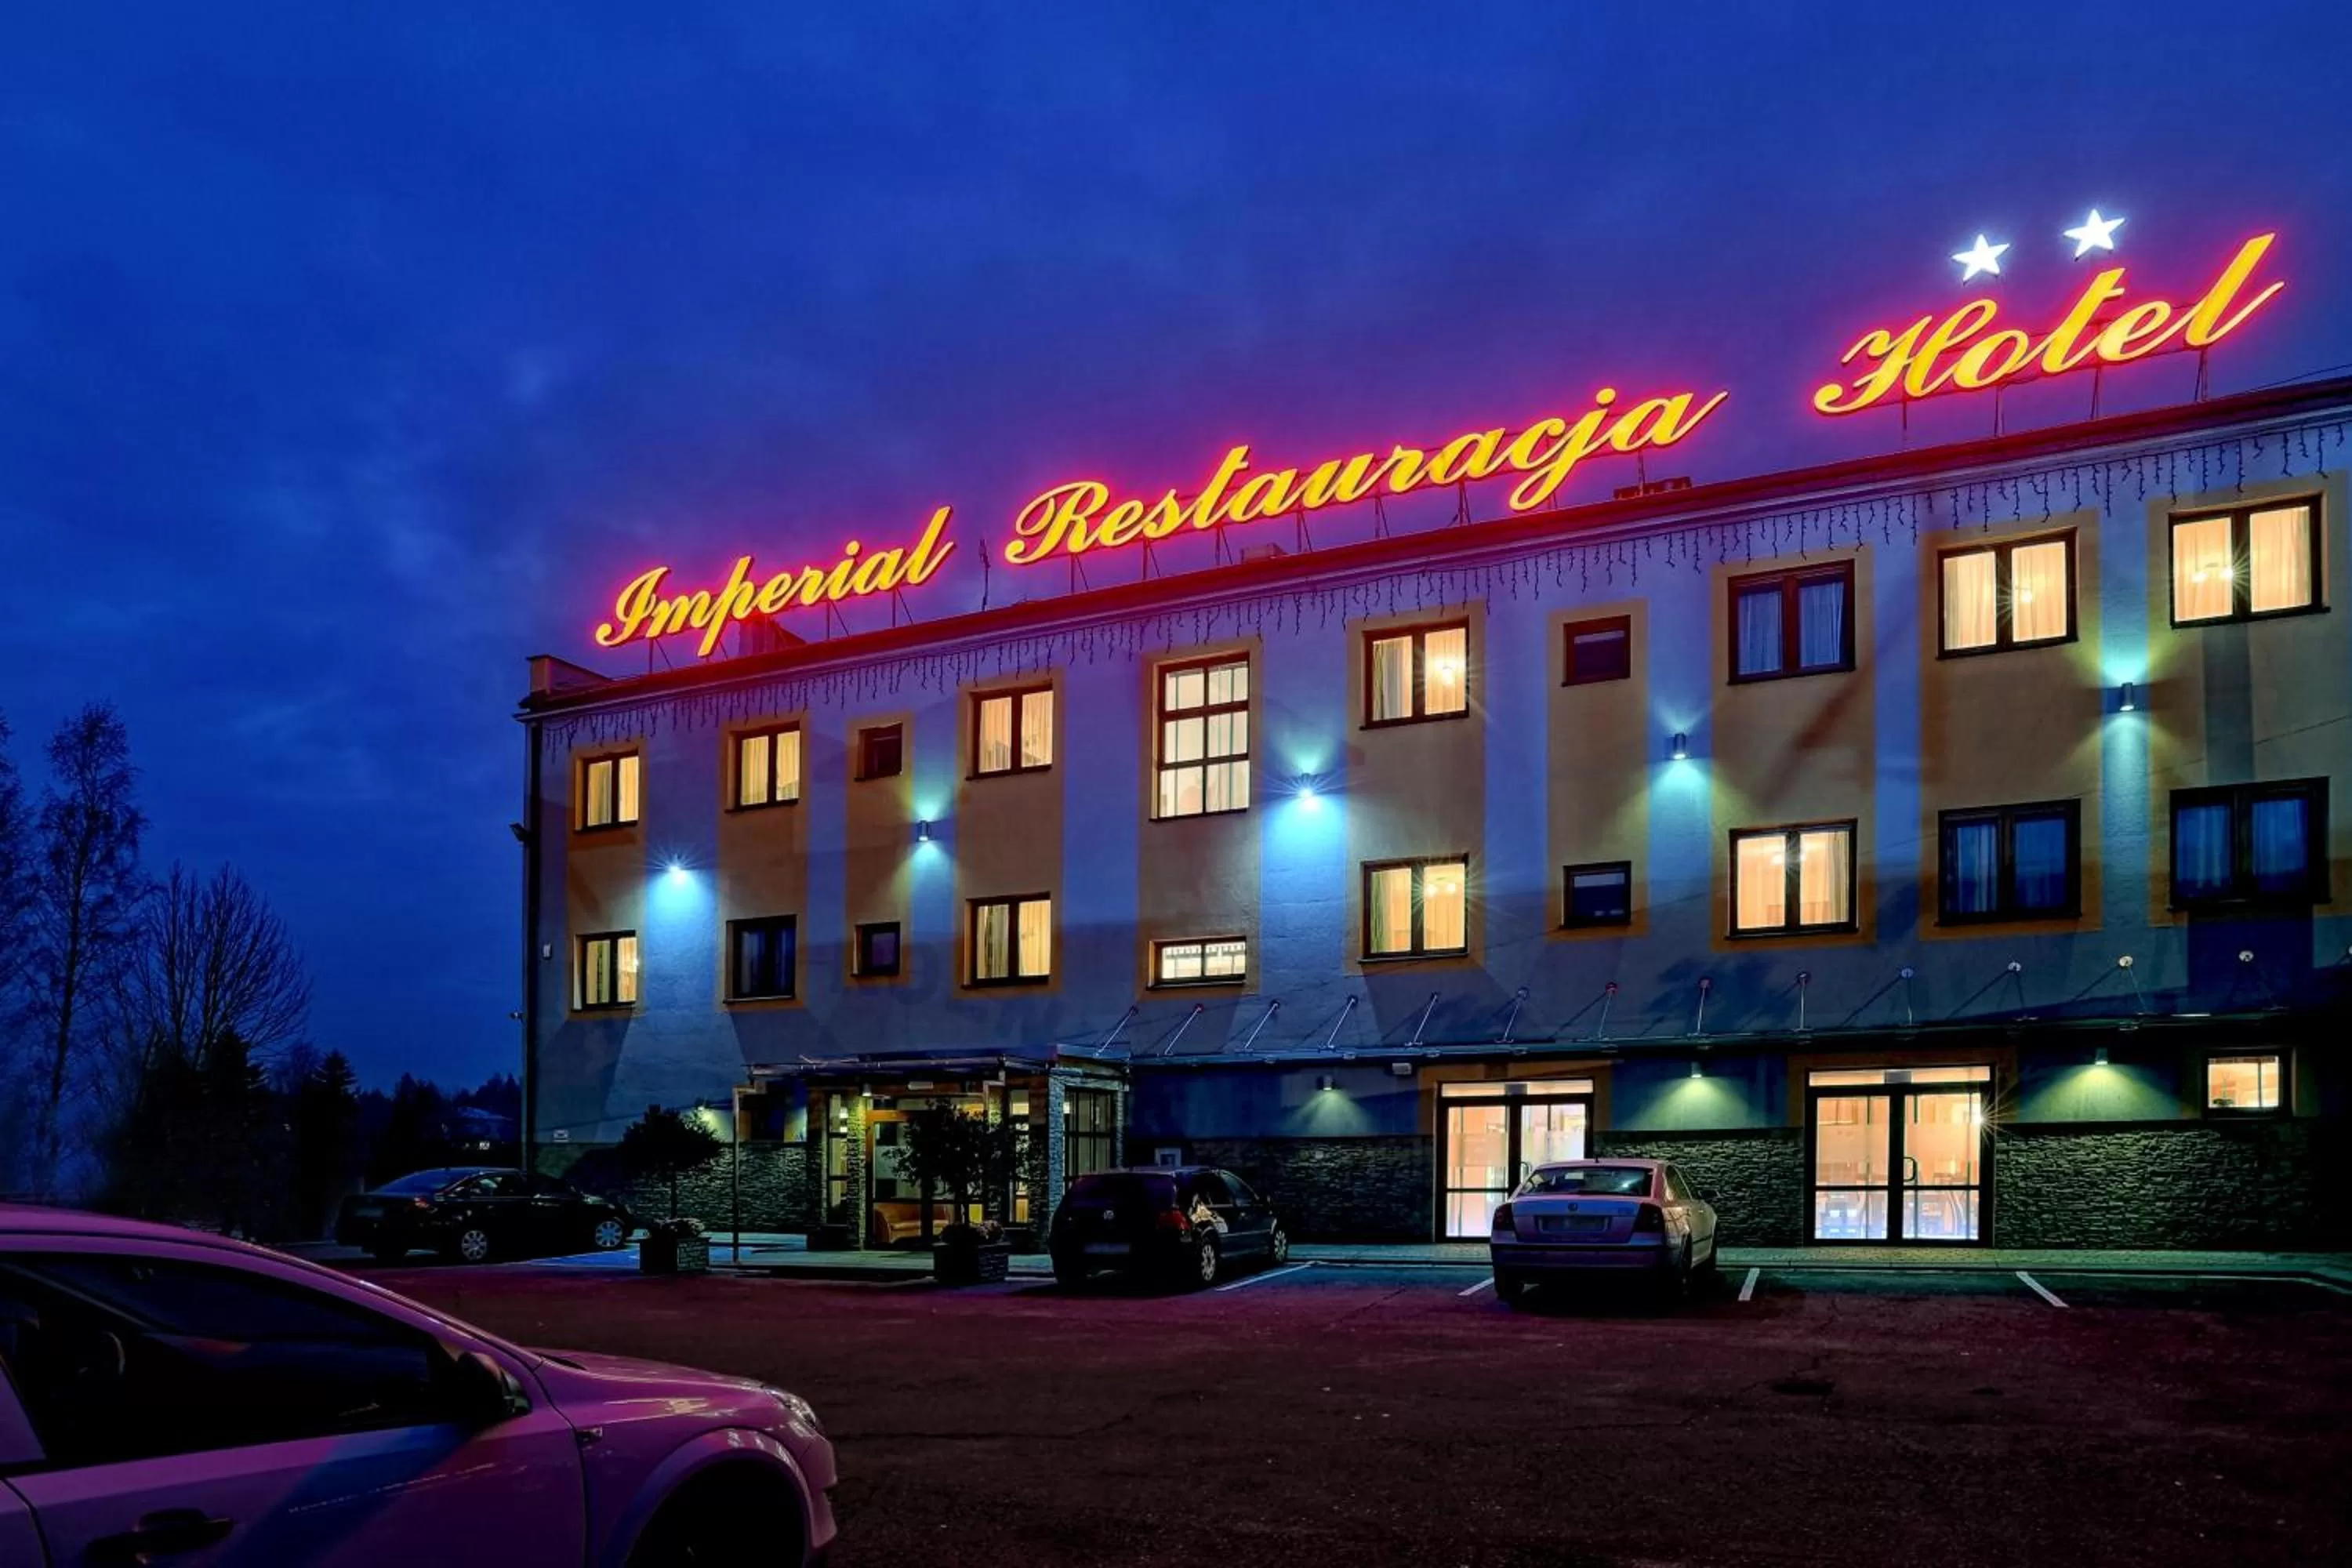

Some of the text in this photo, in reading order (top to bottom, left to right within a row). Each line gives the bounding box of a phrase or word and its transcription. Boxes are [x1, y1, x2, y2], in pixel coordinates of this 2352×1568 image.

[595, 233, 2285, 657] Imperial Restauracja Hotel
